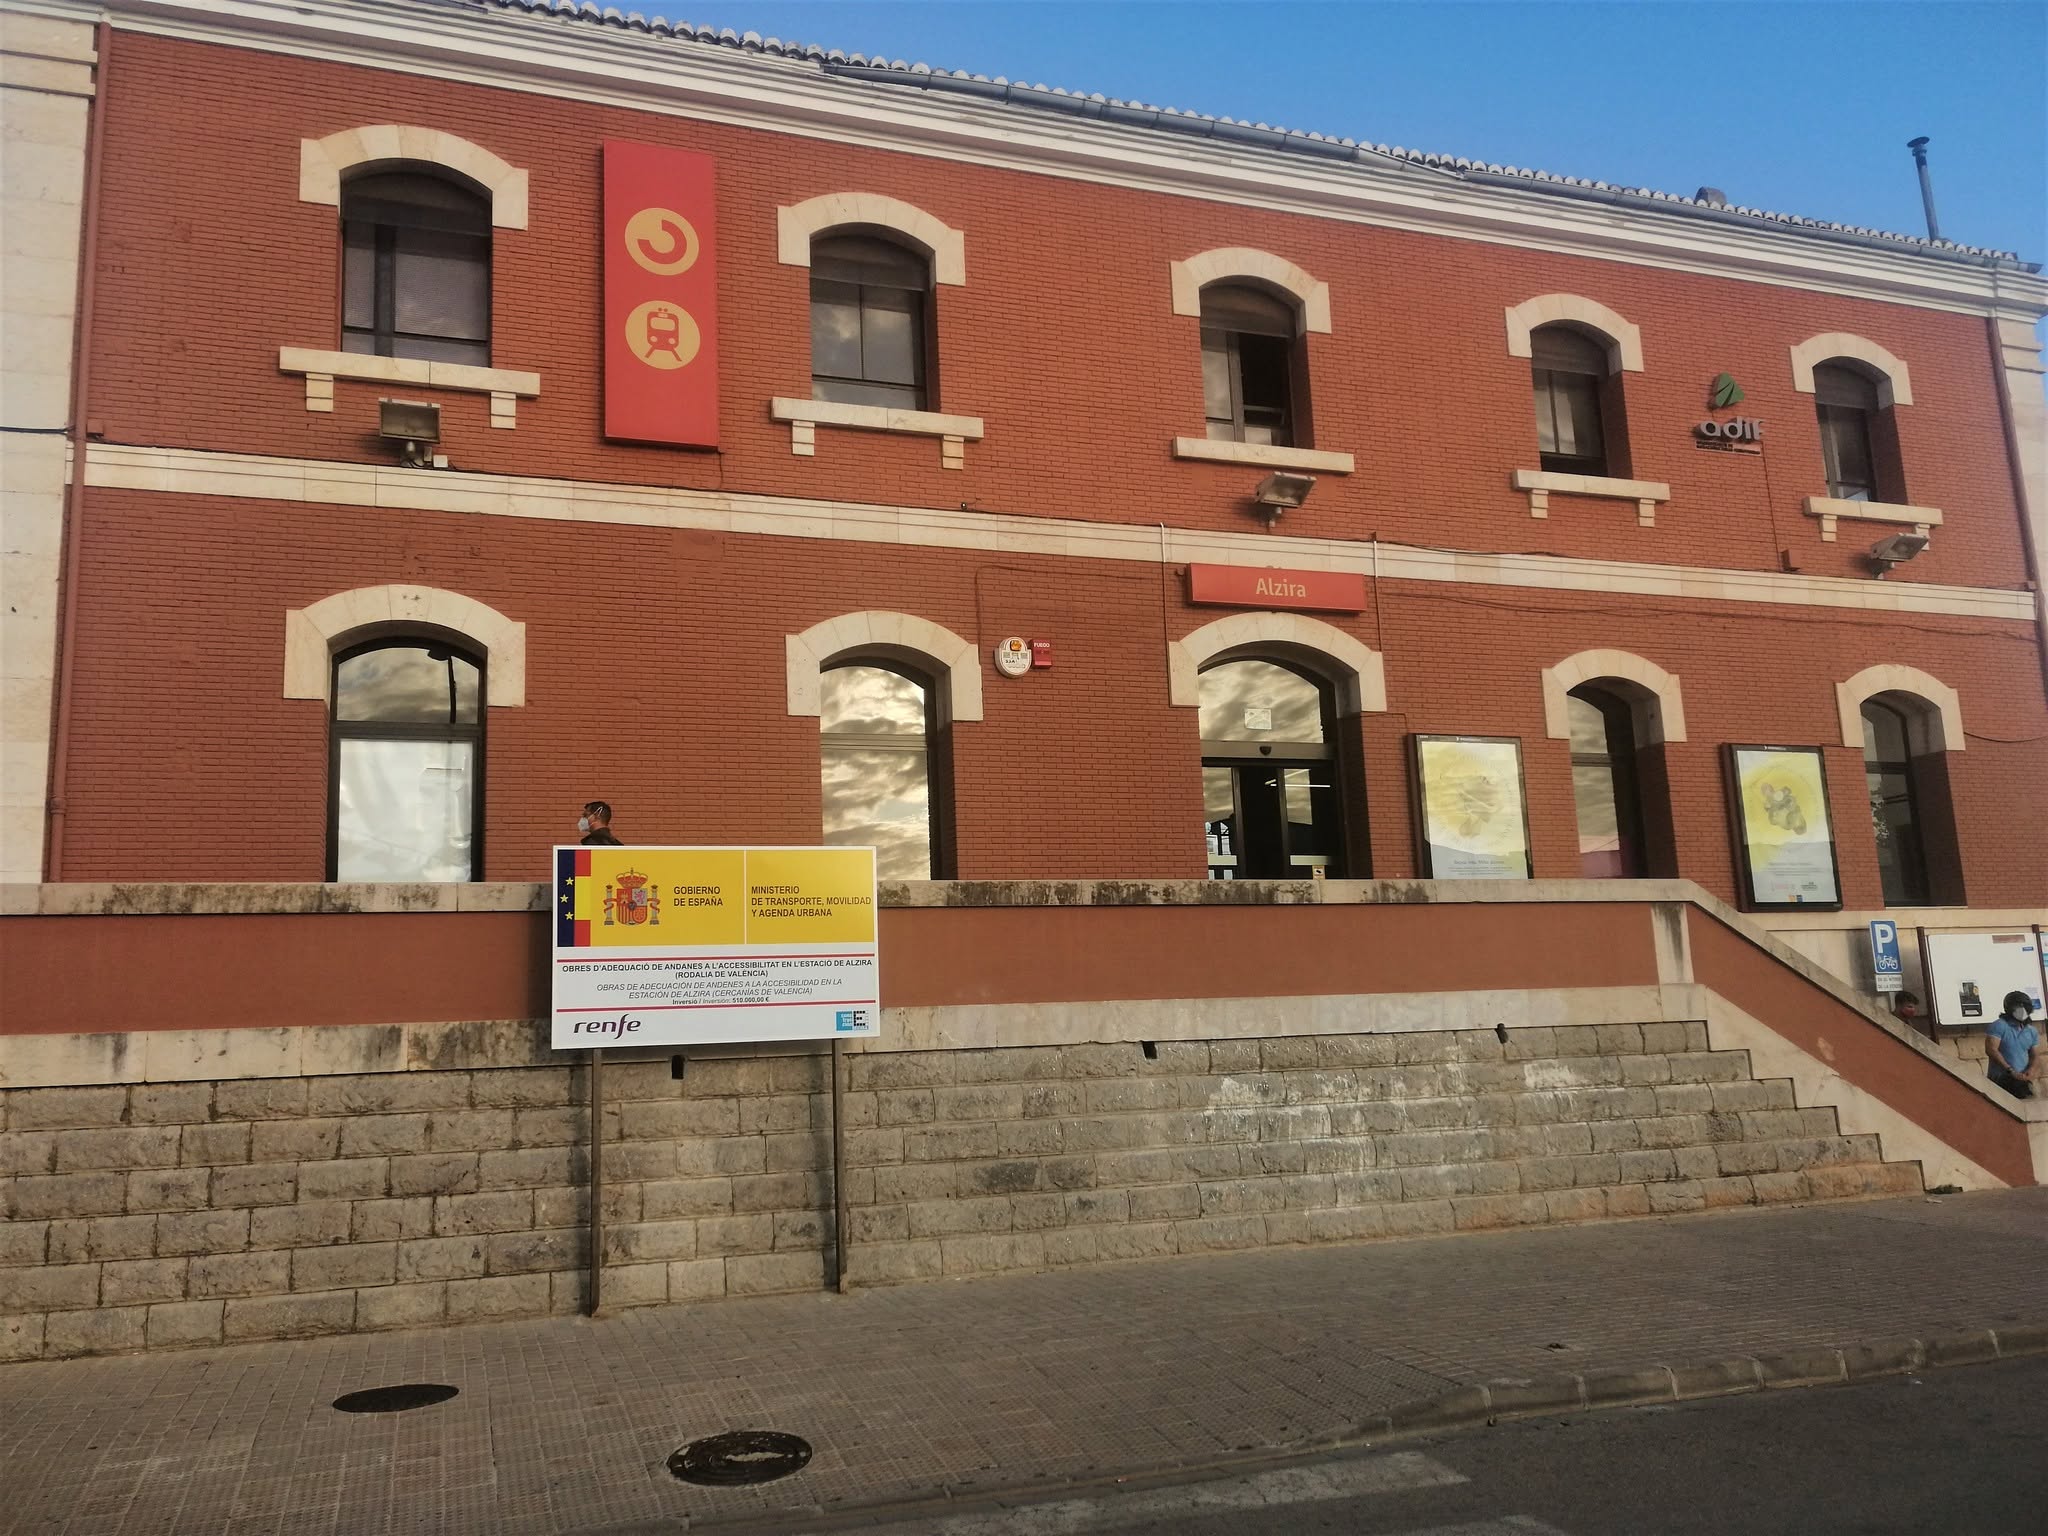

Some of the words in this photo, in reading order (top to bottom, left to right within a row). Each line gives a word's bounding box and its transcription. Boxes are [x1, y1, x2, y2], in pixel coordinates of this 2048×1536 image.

[1700, 416, 1764, 440] adif
[1255, 577, 1307, 598] Alzira
[673, 886, 721, 895] GOBIERNO
[751, 886, 800, 894] MINISTERIO
[673, 898, 685, 907] DE
[688, 896, 723, 906] ESPAÑA
[751, 897, 763, 906] DE
[765, 897, 824, 906] TRANSPORTE,
[826, 896, 871, 905] MOVILIDAD
[752, 909, 757, 917] Y
[758, 908, 795, 917] AGENDA
[796, 908, 832, 917] URBANA
[1875, 924, 1893, 953] P
[593, 964, 650, 972] D'ADEQUACIÓ
[629, 991, 669, 999] ESTACIÓN
[573, 1014, 641, 1040] renfe
